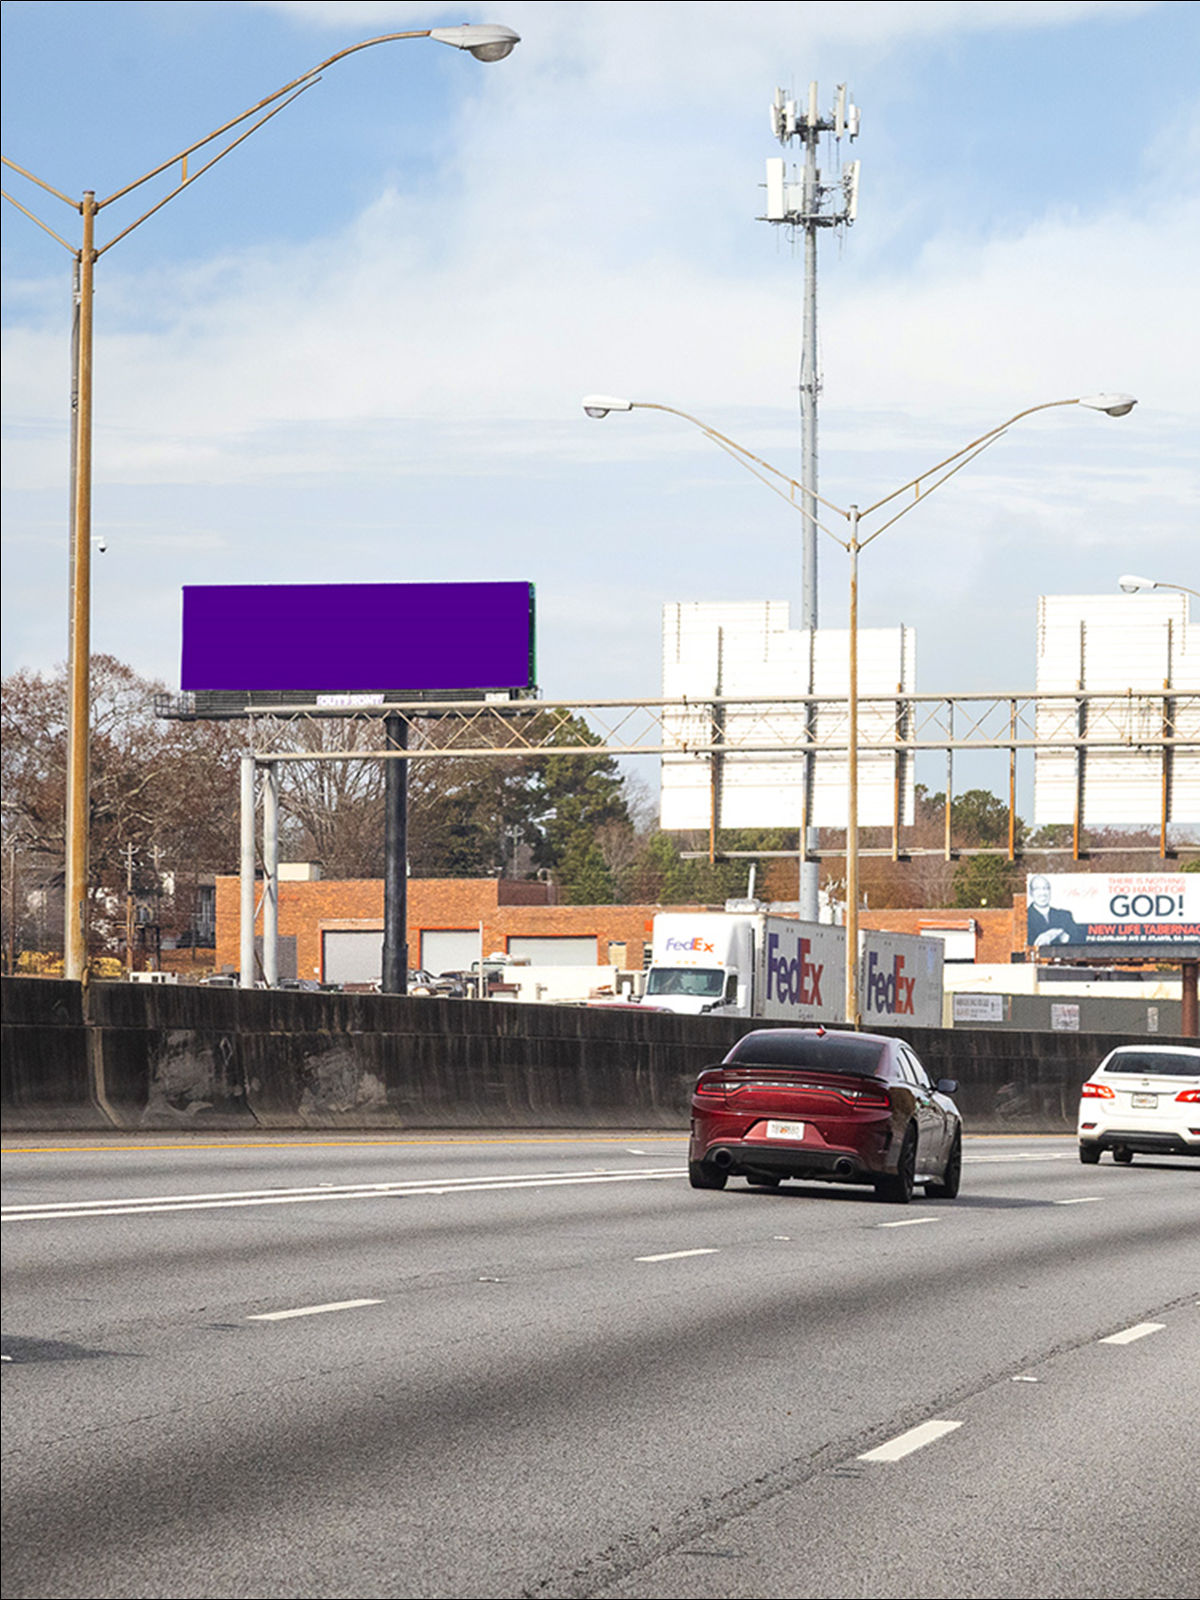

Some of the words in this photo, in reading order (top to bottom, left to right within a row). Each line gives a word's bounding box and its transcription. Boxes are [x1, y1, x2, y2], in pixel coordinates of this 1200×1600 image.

[1108, 877, 1134, 885] THERE
[1136, 877, 1143, 885] IS
[1145, 877, 1186, 885] NOTHING
[1108, 885, 1131, 894] TOO
[1133, 885, 1163, 894] HARD
[1165, 885, 1186, 894] FOR
[1109, 894, 1184, 918] GOD!
[1087, 924, 1117, 935] NEW
[1118, 924, 1141, 935] LIFE
[667, 937, 715, 953] FedEx
[767, 933, 824, 1006] FedEx
[867, 951, 915, 1015] FedEx
